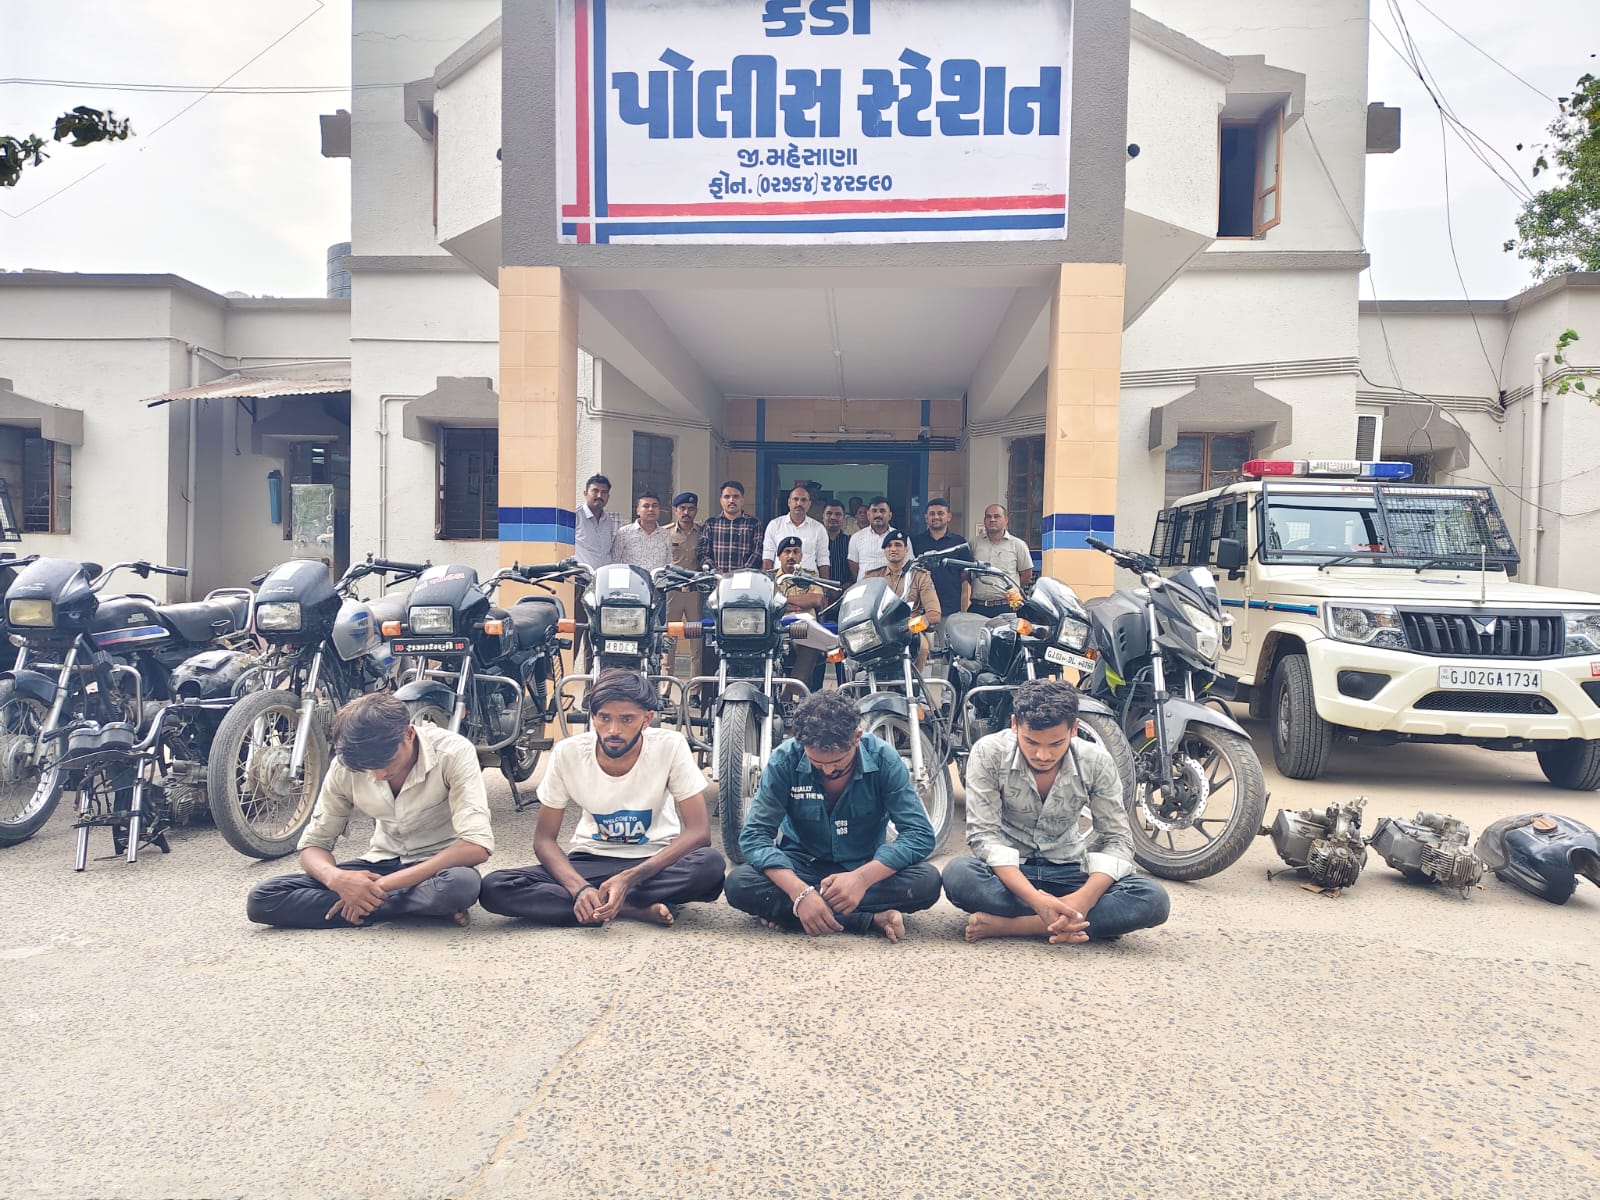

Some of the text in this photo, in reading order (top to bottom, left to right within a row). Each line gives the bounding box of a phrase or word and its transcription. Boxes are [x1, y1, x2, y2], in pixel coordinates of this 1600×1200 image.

[612, 48, 1062, 139] પોલીસ સ્ટેશન
[1450, 670, 1539, 688] GJ02GA1734
